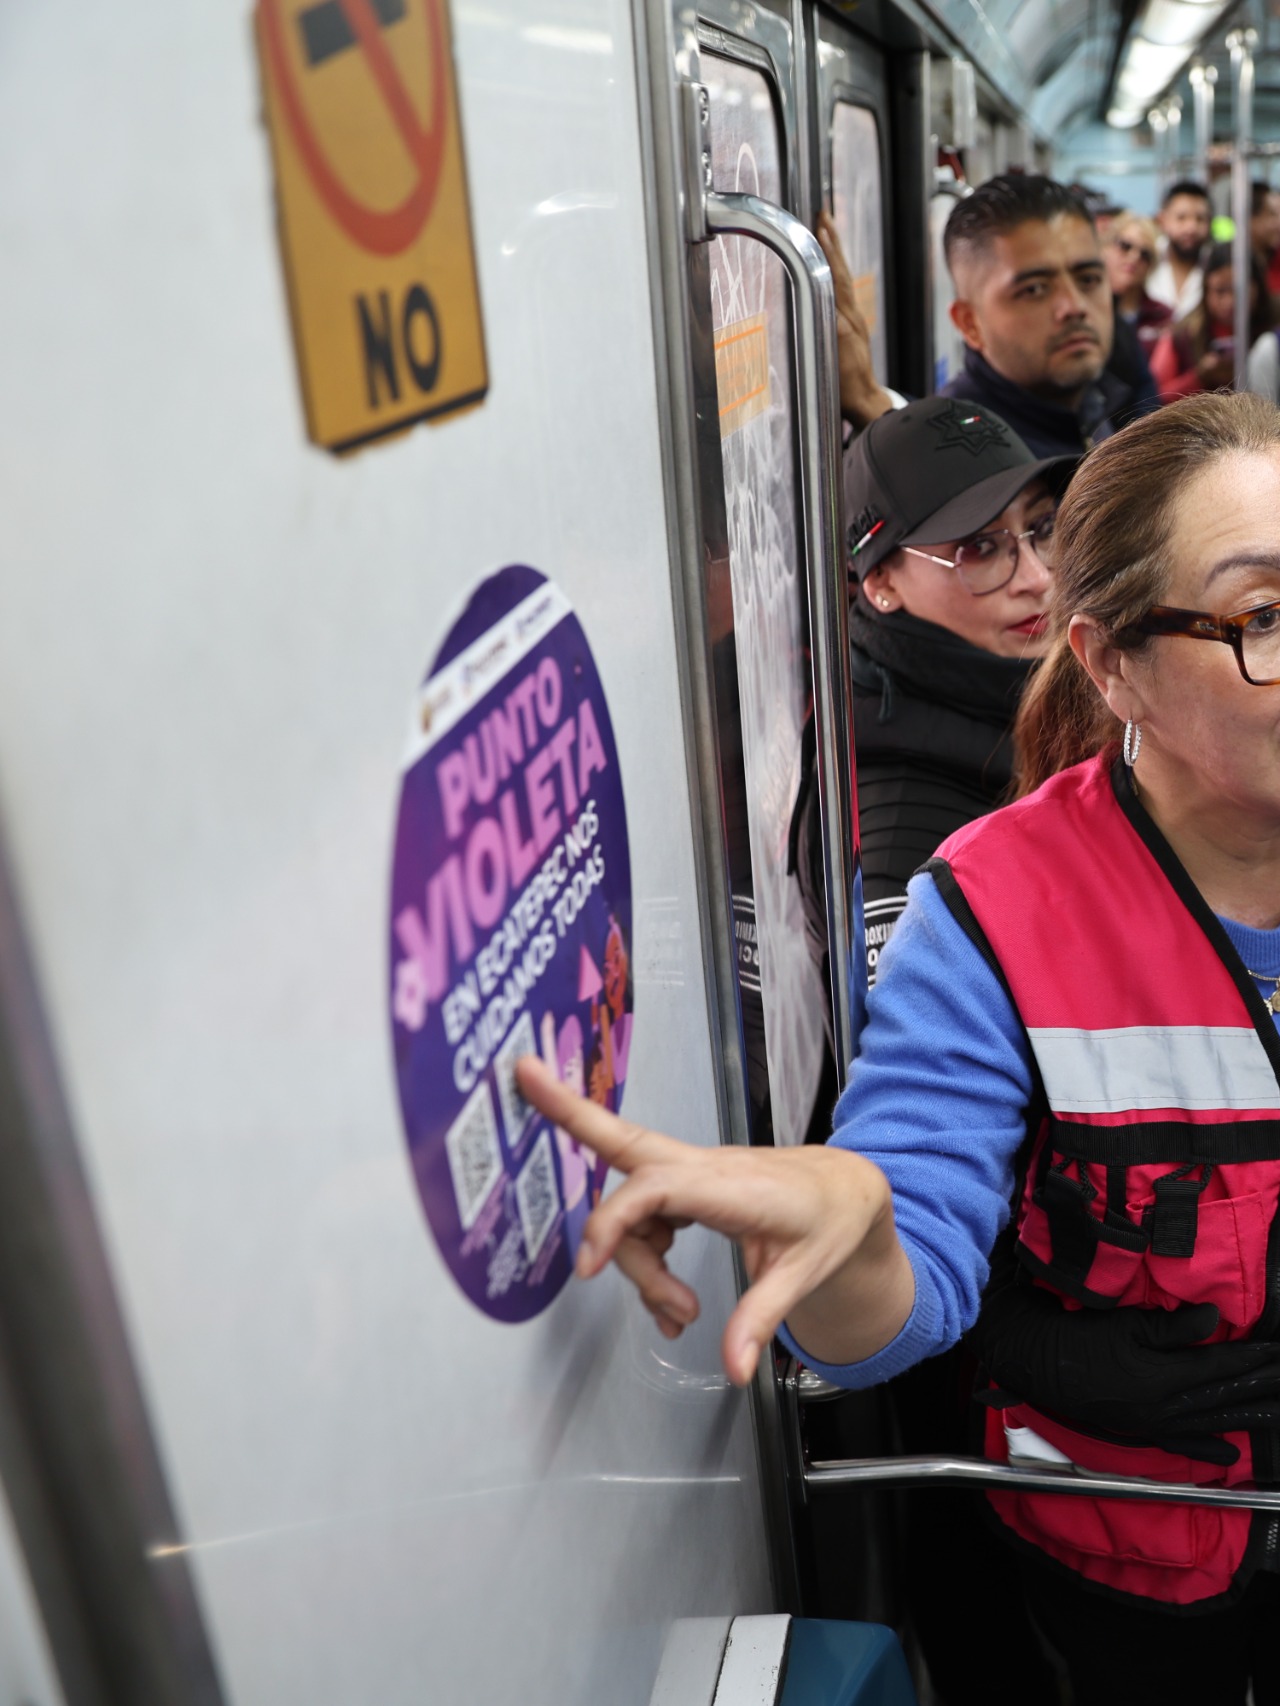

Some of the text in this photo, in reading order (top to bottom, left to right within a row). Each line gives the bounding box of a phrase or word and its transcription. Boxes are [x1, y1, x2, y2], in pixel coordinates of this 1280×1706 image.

[353, 280, 443, 412] NO
[396, 697, 607, 1004] VIOLETA
[437, 656, 563, 840] PUNTO
[442, 799, 600, 1044] EN ECATEPEC NOS
[453, 919, 556, 1092] CUIDAMOS
[552, 843, 605, 937] TODAS
